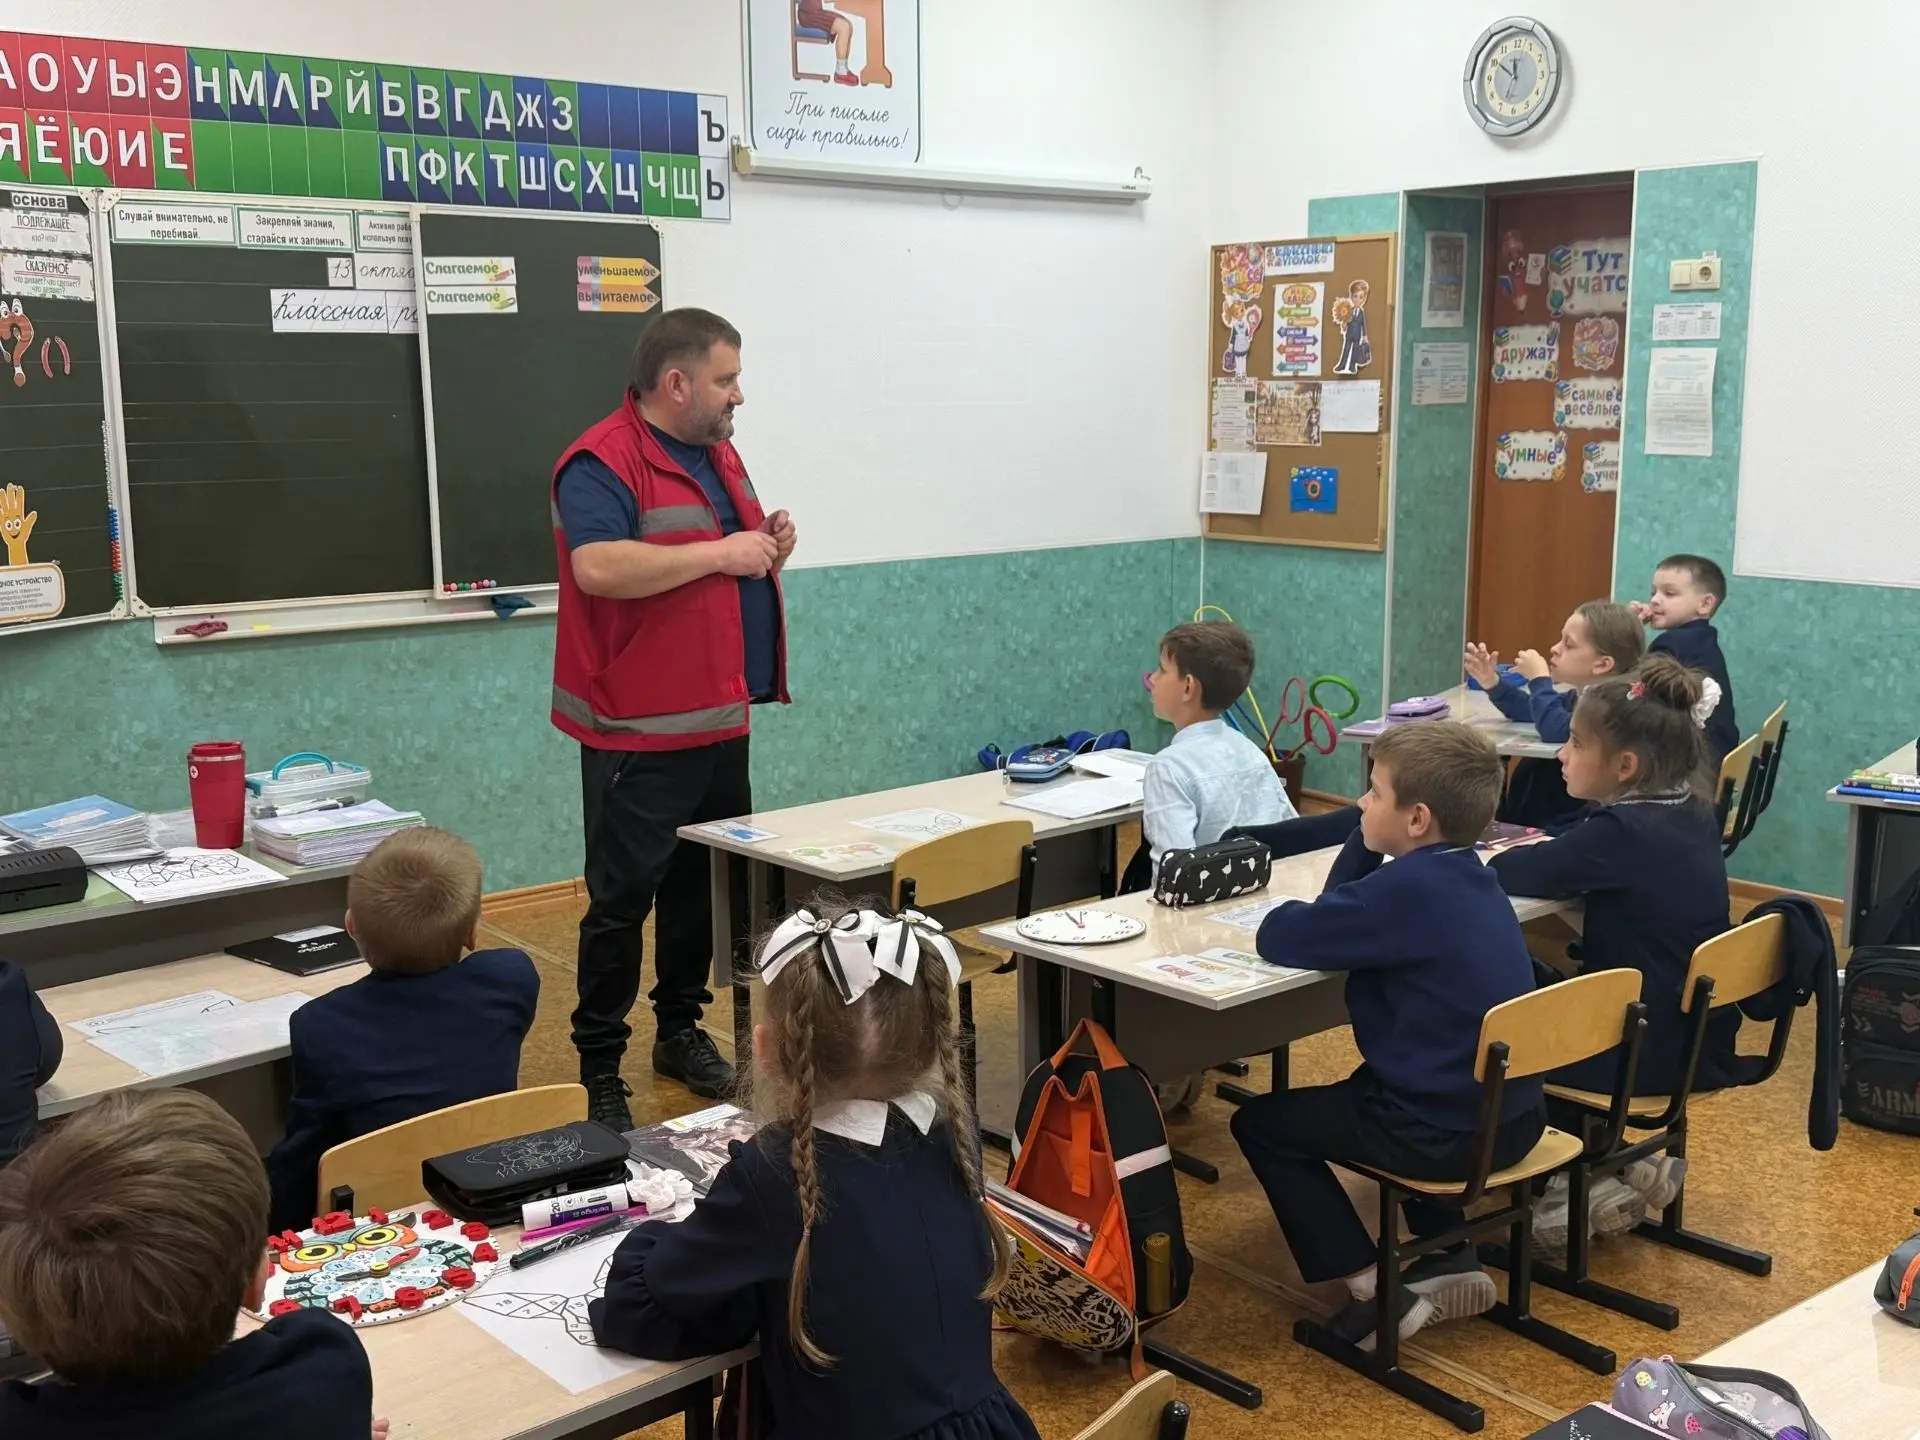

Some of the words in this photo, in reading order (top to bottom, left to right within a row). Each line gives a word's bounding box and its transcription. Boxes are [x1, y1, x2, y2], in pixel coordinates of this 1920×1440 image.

[27, 52, 59, 92] О
[71, 55, 98, 94] У
[110, 59, 146, 99] Ы
[155, 62, 182, 101] Э
[194, 65, 221, 104] Н
[229, 68, 264, 107] М
[310, 75, 333, 111] Р
[347, 69, 371, 115] Й
[382, 82, 406, 117] Б
[417, 84, 441, 120] В
[454, 87, 471, 121] Г
[485, 90, 511, 132] Д
[517, 92, 544, 128] Ж
[552, 96, 573, 131] З
[701, 110, 725, 142] Ъ
[785, 91, 825, 125] При
[830, 104, 890, 123] письме
[766, 124, 807, 149] сиди
[812, 124, 909, 152] правильно!
[0, 122, 21, 162] Я
[35, 115, 63, 164] Ё
[72, 126, 110, 166] Ю
[119, 129, 147, 168] И
[163, 132, 188, 170] Е
[386, 147, 409, 182] П
[418, 148, 447, 185] Ф
[455, 151, 478, 186] К
[489, 154, 509, 188] Т
[520, 157, 546, 191] Ш
[554, 158, 576, 193] С
[586, 161, 607, 194] Х
[615, 163, 638, 203] Ц
[647, 165, 666, 198] Ч
[673, 168, 699, 206] Щ
[707, 169, 725, 200] Ь
[17, 215, 70, 229] ПОДЛЕЖАЩЕЕ
[119, 210, 153, 223] Слушай
[156, 213, 216, 224] внимательно,
[218, 215, 228, 223] не
[256, 214, 301, 227] Закрепляй
[303, 218, 335, 230] знания,
[369, 220, 395, 230] Активно
[151, 228, 200, 240] перебивай.
[247, 234, 286, 244] старайся
[300, 237, 345, 247] запомнить.
[25, 260, 69, 274] СКАЗУЕМОЕ
[425, 261, 499, 274] Слагаемое
[1582, 249, 1623, 273] Тут
[334, 259, 351, 279] 13
[578, 266, 656, 278] уменьшаемое
[427, 289, 500, 302] Слагаемое
[578, 292, 654, 303] вычитаемое
[1501, 346, 1555, 366] дружат
[1572, 389, 1613, 402] самые
[1565, 403, 1620, 416] весёлые
[1507, 448, 1557, 466] умные
[495, 1299, 512, 1308] 18
